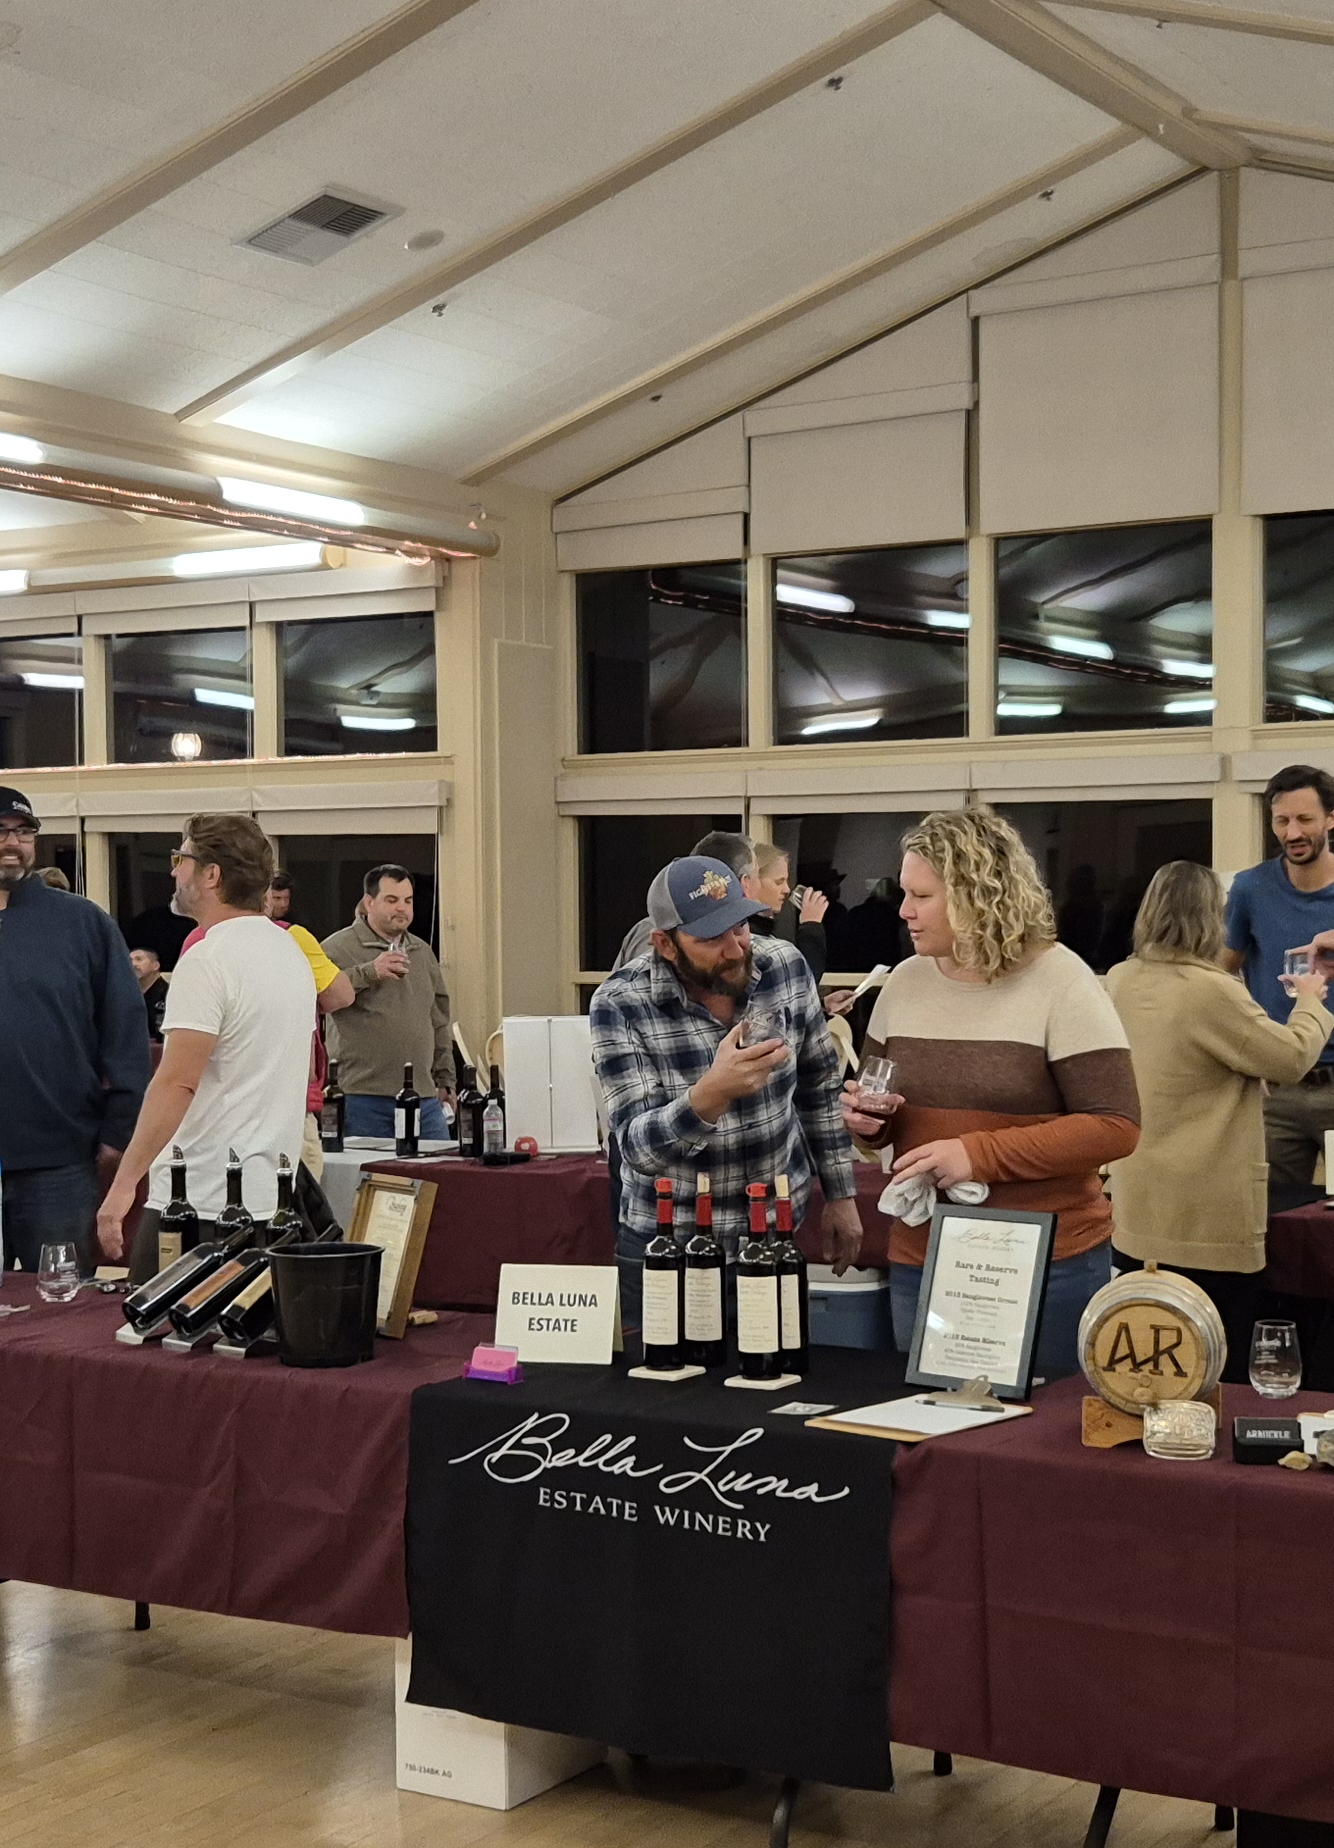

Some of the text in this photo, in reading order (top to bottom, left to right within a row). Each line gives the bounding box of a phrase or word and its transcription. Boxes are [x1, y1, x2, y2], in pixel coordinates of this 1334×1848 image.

[955, 1261, 974, 1270] Rare
[969, 1274, 1000, 1286] Tasting
[512, 1292, 598, 1307] BELLA LUNA
[528, 1317, 578, 1332] ESTATE
[1102, 1322, 1188, 1378] AR
[448, 1412, 850, 1510] Bella Luna
[538, 1487, 772, 1542] ESTATE WINERY
